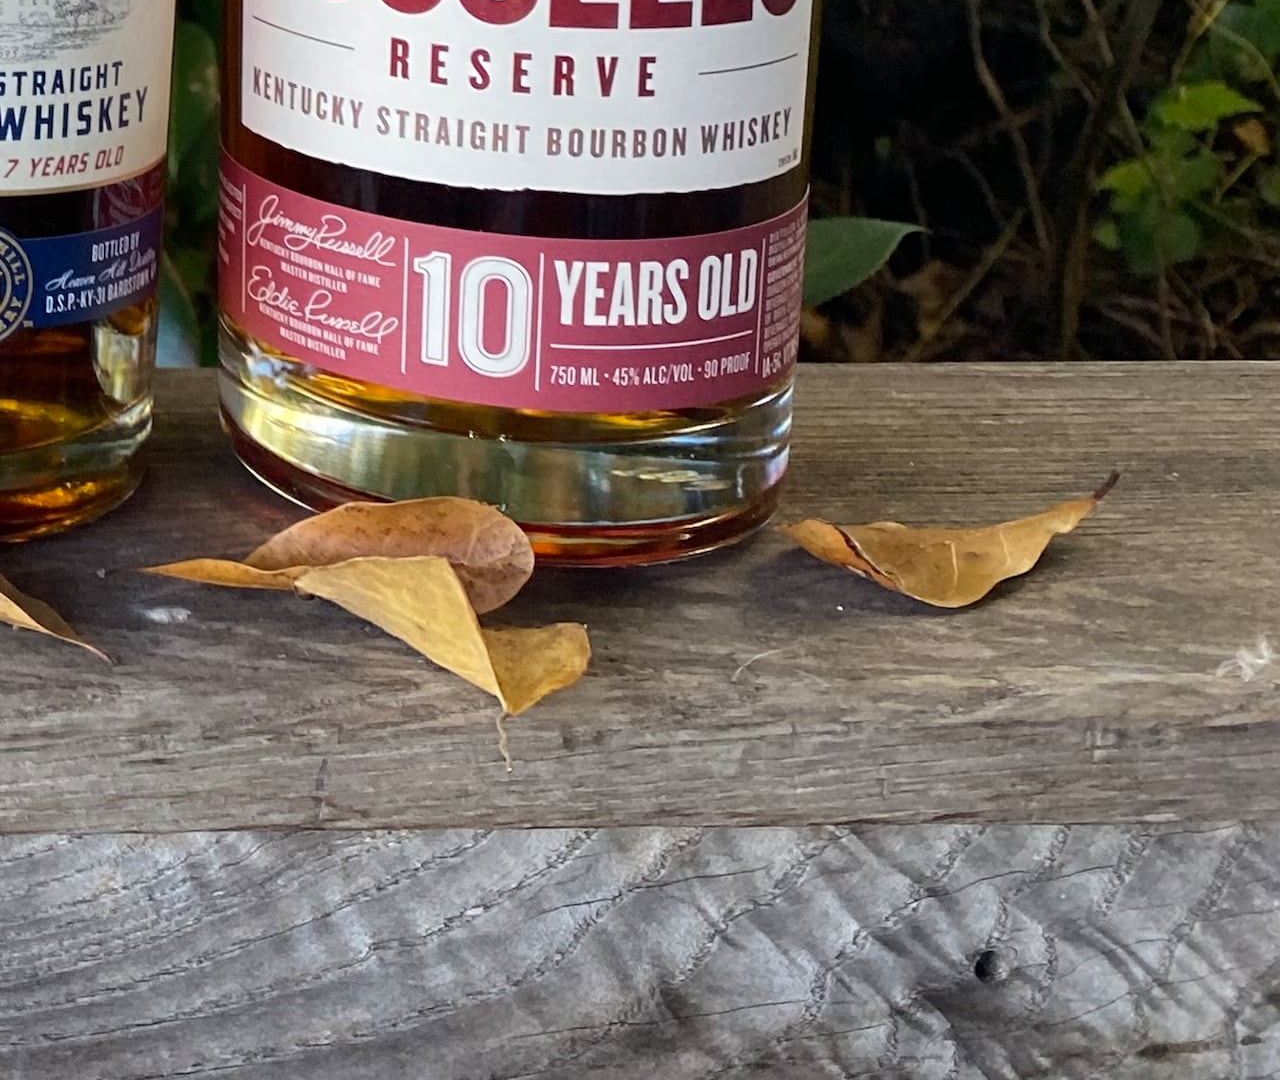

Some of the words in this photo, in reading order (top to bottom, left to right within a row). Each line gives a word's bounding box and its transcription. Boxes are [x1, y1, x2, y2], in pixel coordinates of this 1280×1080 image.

[389, 36, 657, 98] RESERVE
[252, 66, 364, 130] KENTUCKY
[376, 105, 531, 155] STRAIGHT
[546, 126, 687, 159] BOURBON
[700, 107, 793, 153] WHISKEY
[4, 158, 19, 178] 7
[30, 153, 88, 178] YEARS
[94, 145, 124, 169] OLD
[314, 215, 396, 266] Russell
[248, 265, 303, 316] Eddie
[413, 250, 534, 378] 10
[554, 257, 689, 327] YEARS
[698, 248, 758, 321] OLD
[550, 365, 576, 386] 750
[580, 367, 600, 386] ML
[612, 368, 640, 386] 45%
[643, 362, 694, 385] ALC/VOL
[704, 360, 718, 379] 90
[721, 351, 751, 375] PROOF
